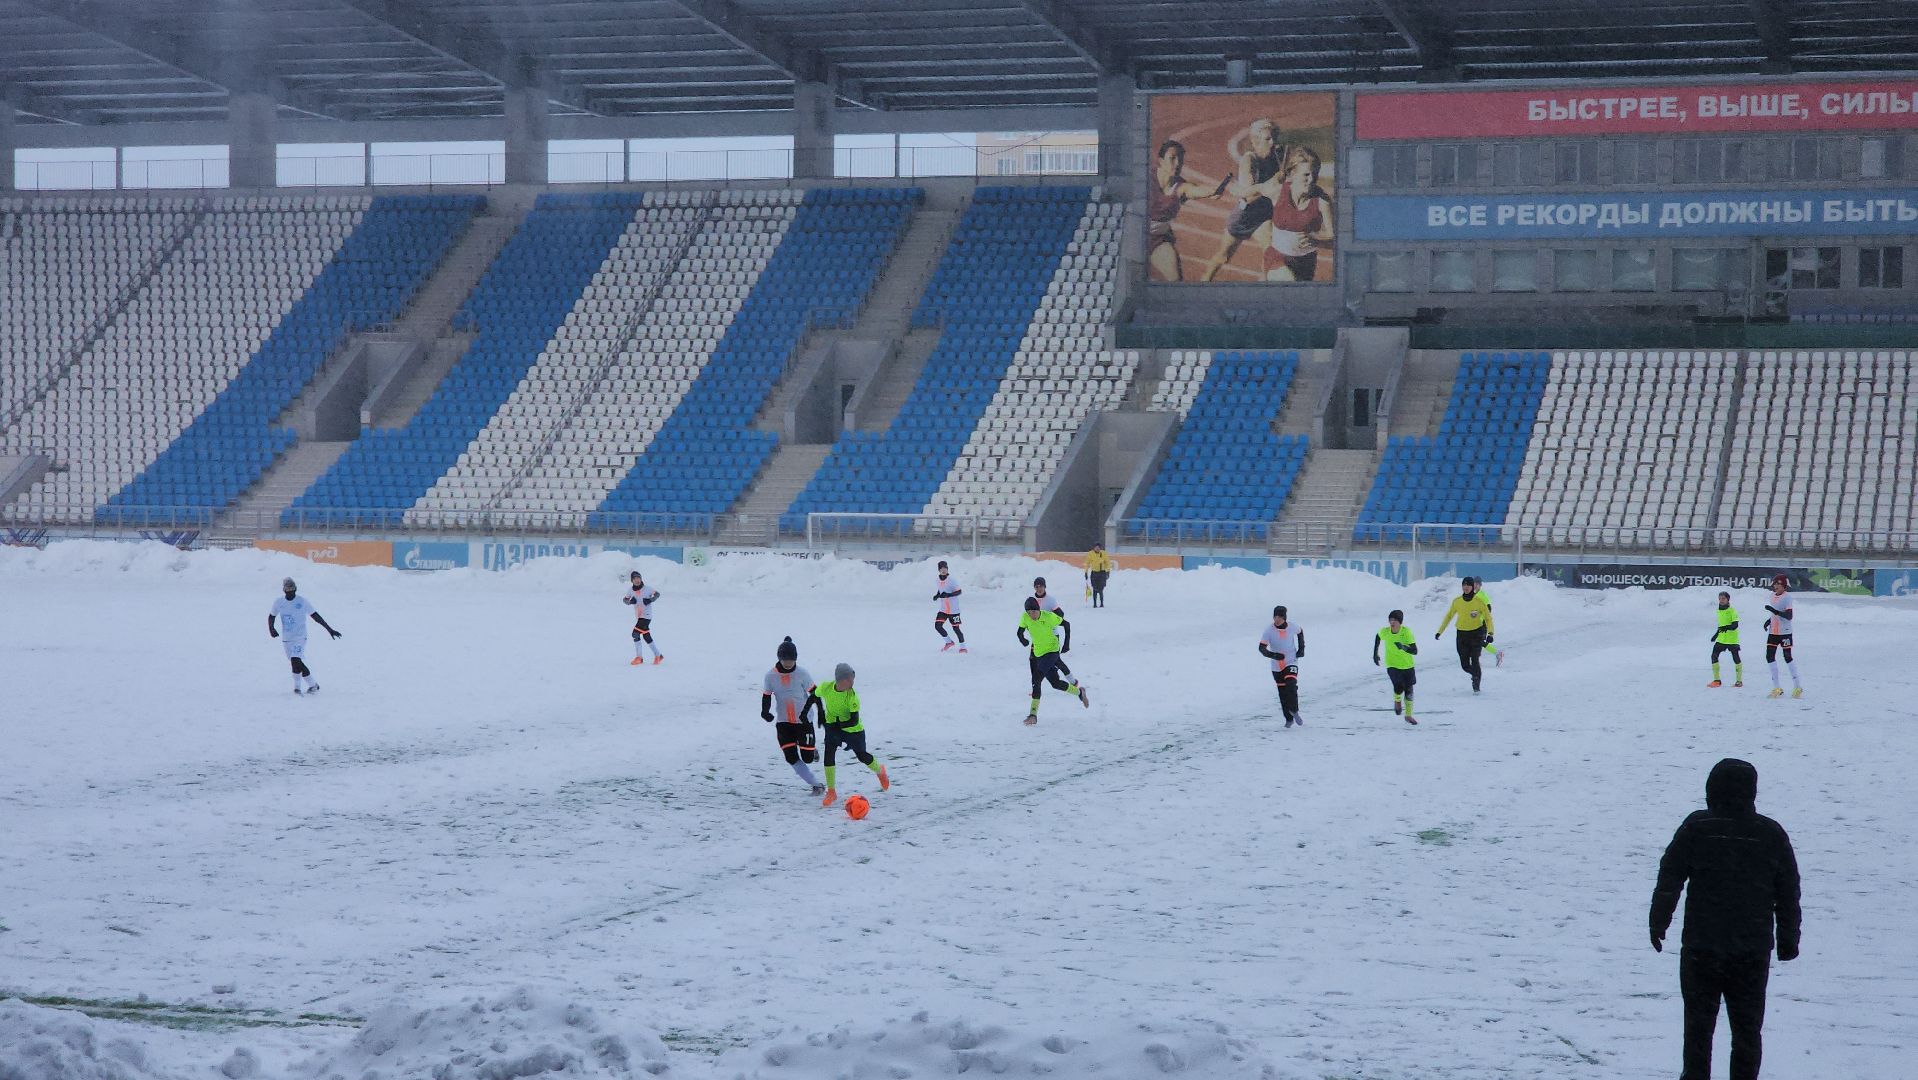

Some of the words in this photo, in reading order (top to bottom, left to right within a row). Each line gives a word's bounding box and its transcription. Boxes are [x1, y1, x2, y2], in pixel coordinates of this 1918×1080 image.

[1528, 96, 1687, 123] БЫСТРЕЕ,
[1698, 94, 1809, 120] ВЫШЕ,
[1428, 205, 1487, 226] ВСЕ
[1497, 203, 1649, 229] РЕКОРДЫ
[1659, 201, 1812, 228] ДОЛЖНЫ
[1823, 199, 1918, 222] БЫТЬ
[1581, 574, 1666, 586] ЮНОШЕСКАЯ
[1668, 575, 1756, 588] ФУТБОЛЬНАЯ
[1758, 577, 1792, 588] ЛИА
[1819, 578, 1863, 590] ЦЕНТР
